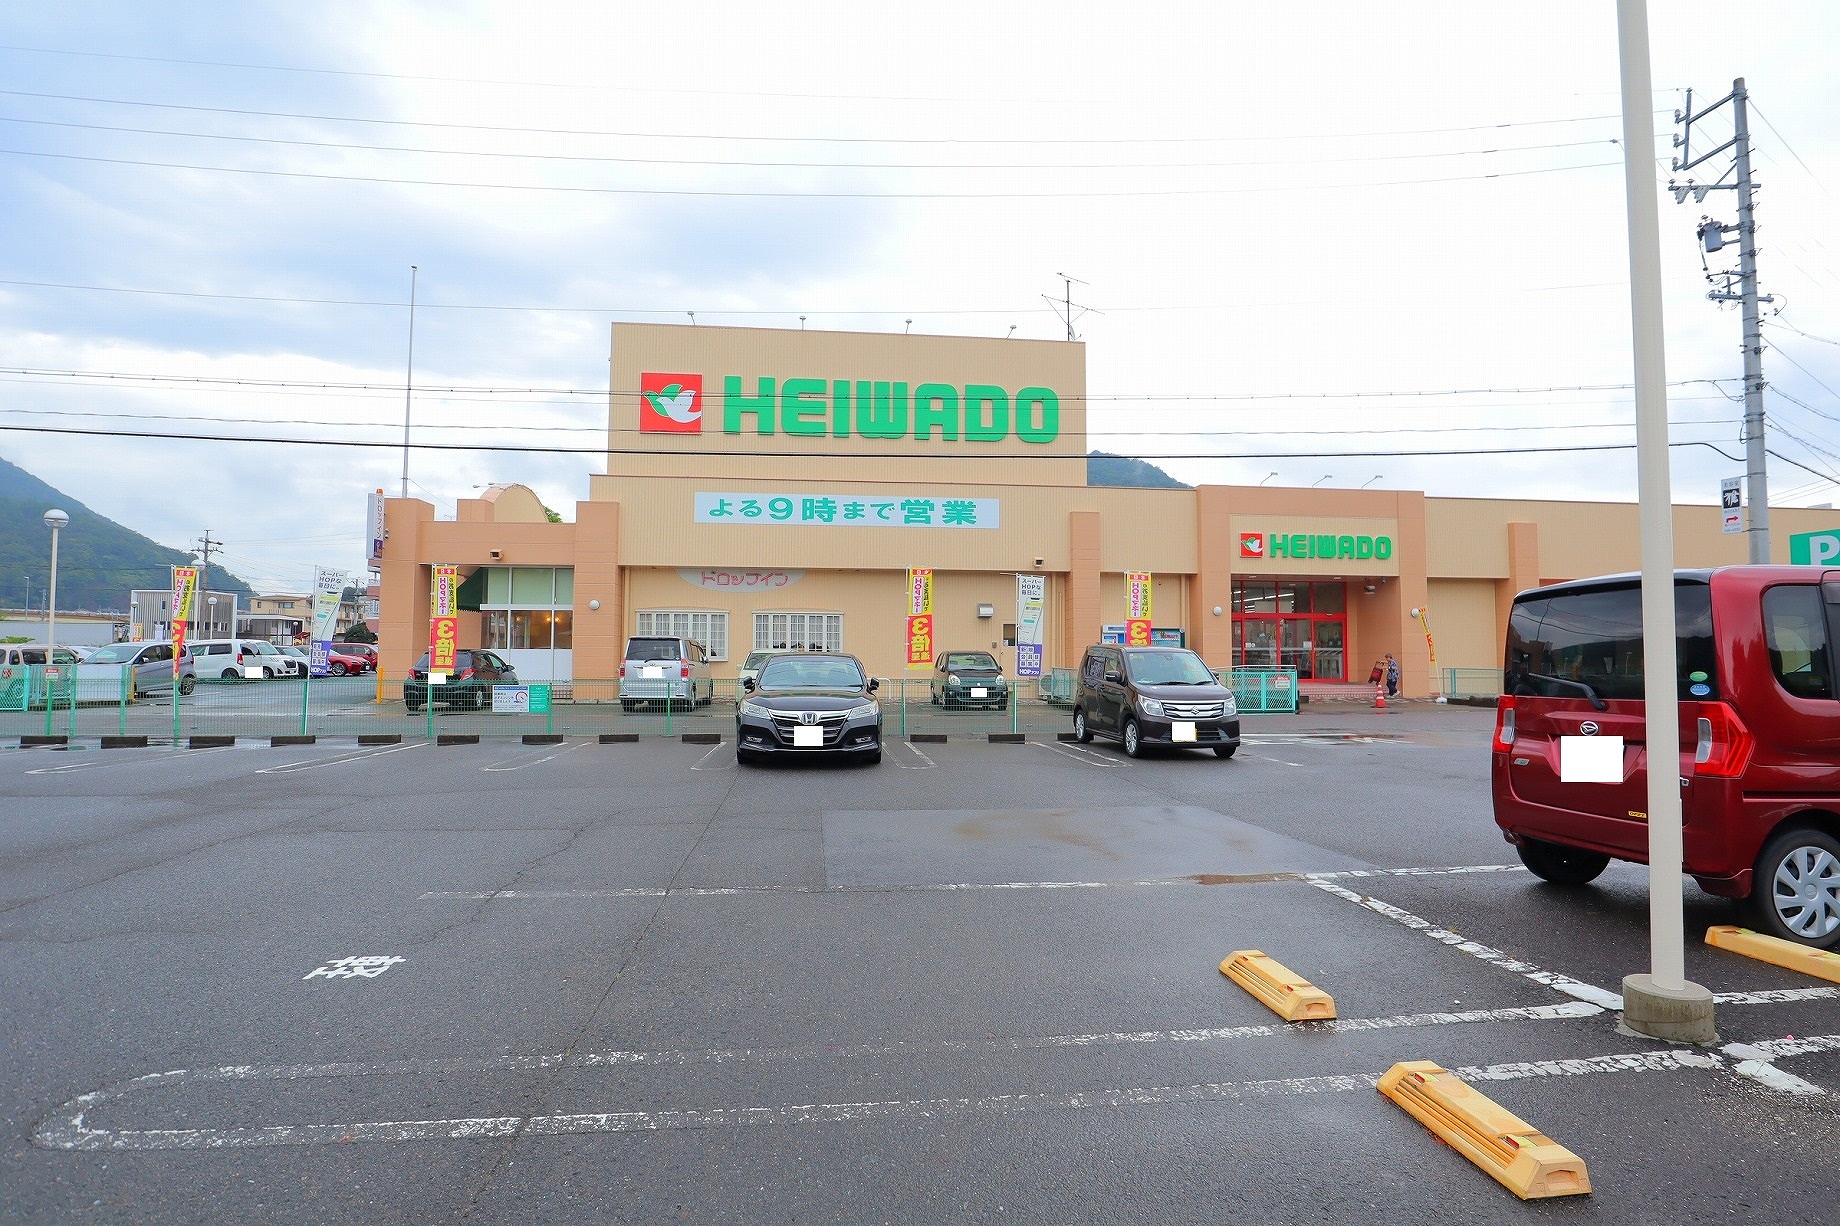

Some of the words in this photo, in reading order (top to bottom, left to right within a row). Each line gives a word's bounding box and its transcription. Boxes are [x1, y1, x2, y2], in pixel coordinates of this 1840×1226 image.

[724, 375, 1060, 443] HEIWADO
[708, 497, 977, 525] よる9時まで営業
[1270, 534, 1392, 560] HEIWADO
[302, 955, 407, 980] 軽
